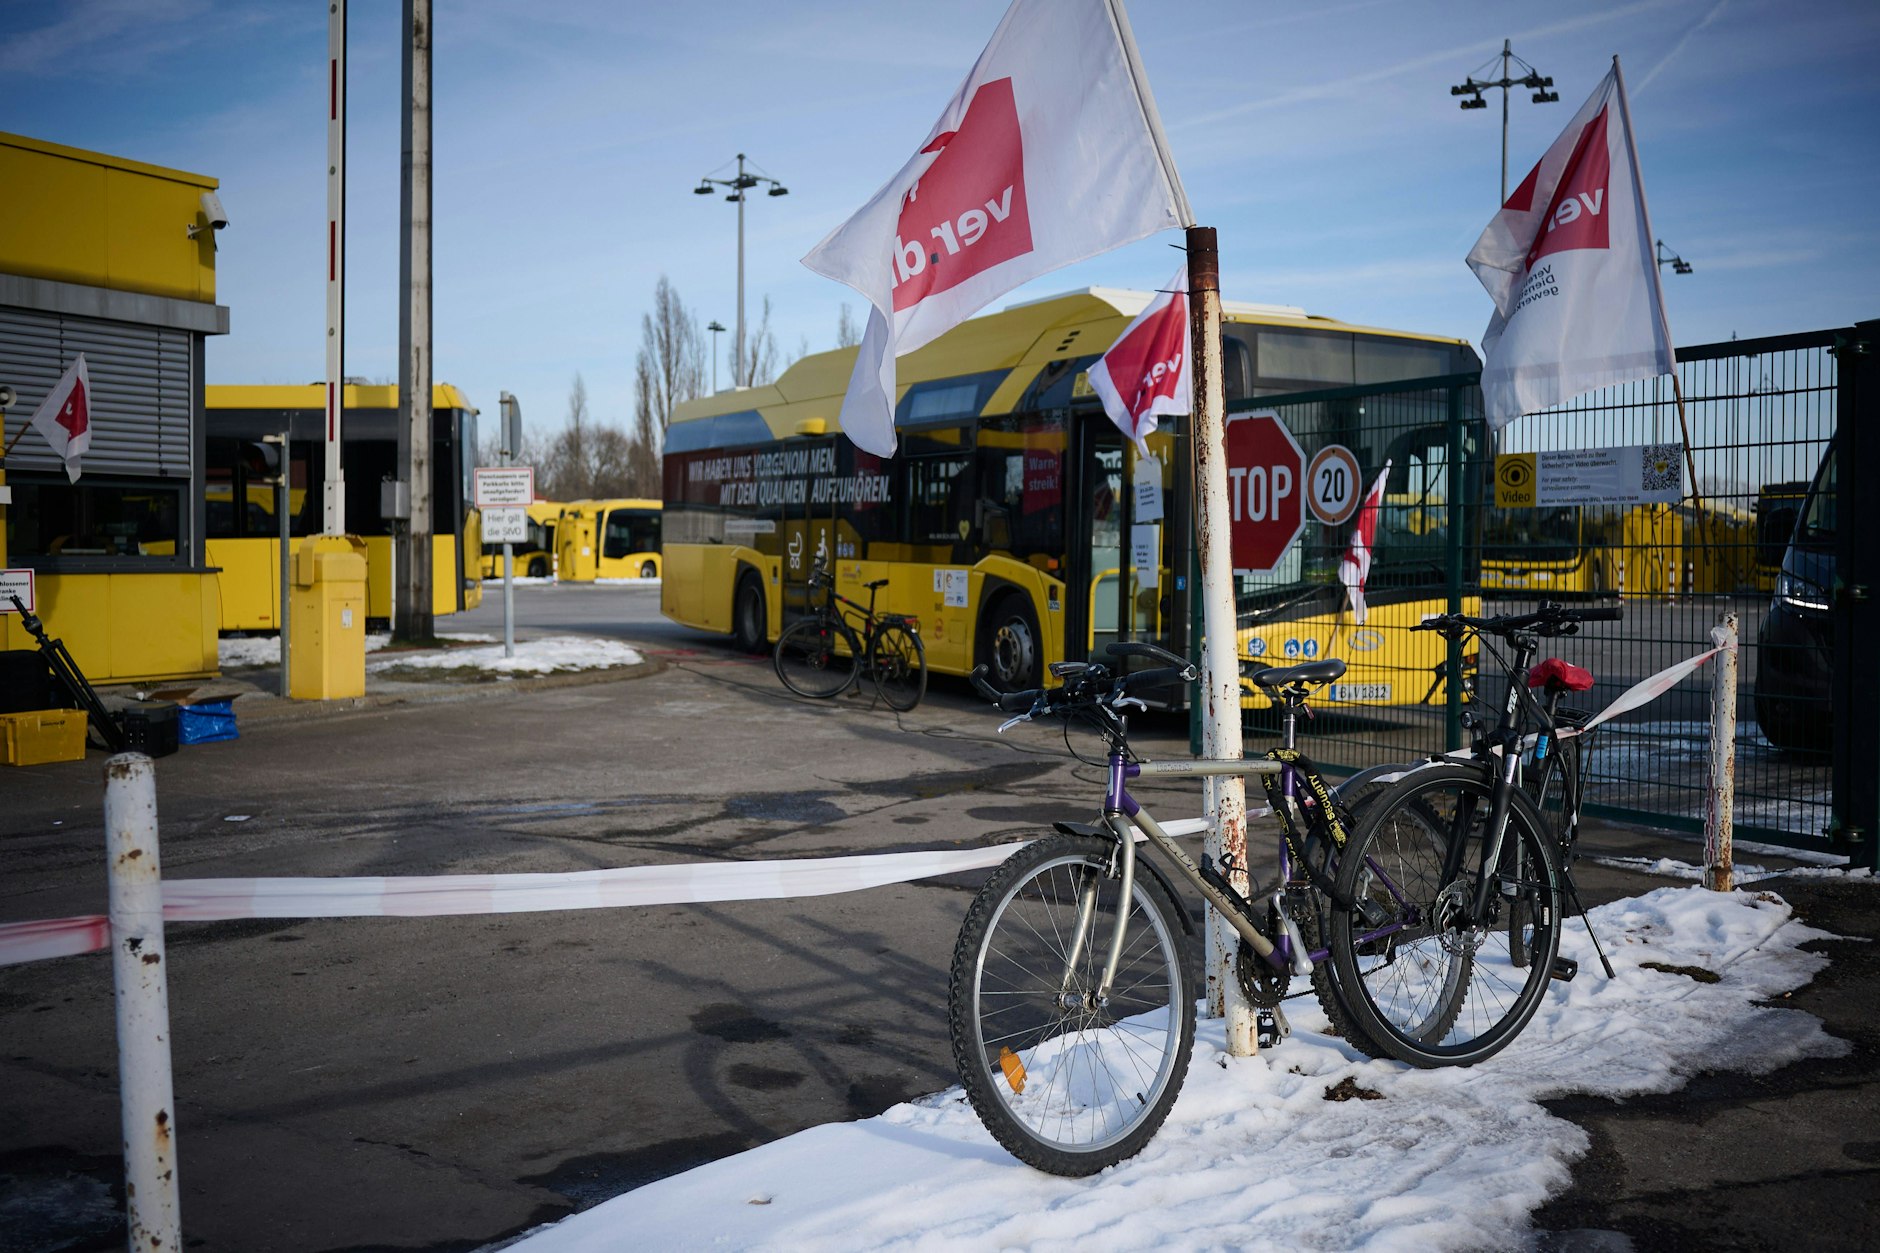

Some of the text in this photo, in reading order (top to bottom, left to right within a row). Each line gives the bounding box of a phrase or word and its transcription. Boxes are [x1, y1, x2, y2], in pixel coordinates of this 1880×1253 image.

[1029, 457, 1058, 471] Warn-
[1557, 453, 1575, 461] Bereich
[1576, 452, 1588, 460] wird
[689, 459, 704, 482] WIR
[704, 456, 732, 480] HABEN
[733, 455, 752, 478] UNS
[753, 448, 837, 477] VORGENOMMEN,
[1541, 461, 1565, 469] Sicherheit
[720, 483, 737, 505] MIT
[737, 482, 758, 505] DEM
[758, 479, 808, 507] QUALMEN
[811, 470, 892, 502] AUFZUHÖREN.
[1029, 475, 1058, 491] streik!
[1322, 468, 1345, 503] 20
[1229, 465, 1293, 522] TOP
[1502, 491, 1530, 503] Video
[488, 514, 520, 524] Hier gilt
[488, 528, 500, 536] die
[1308, 774, 1336, 821] SECURITY
